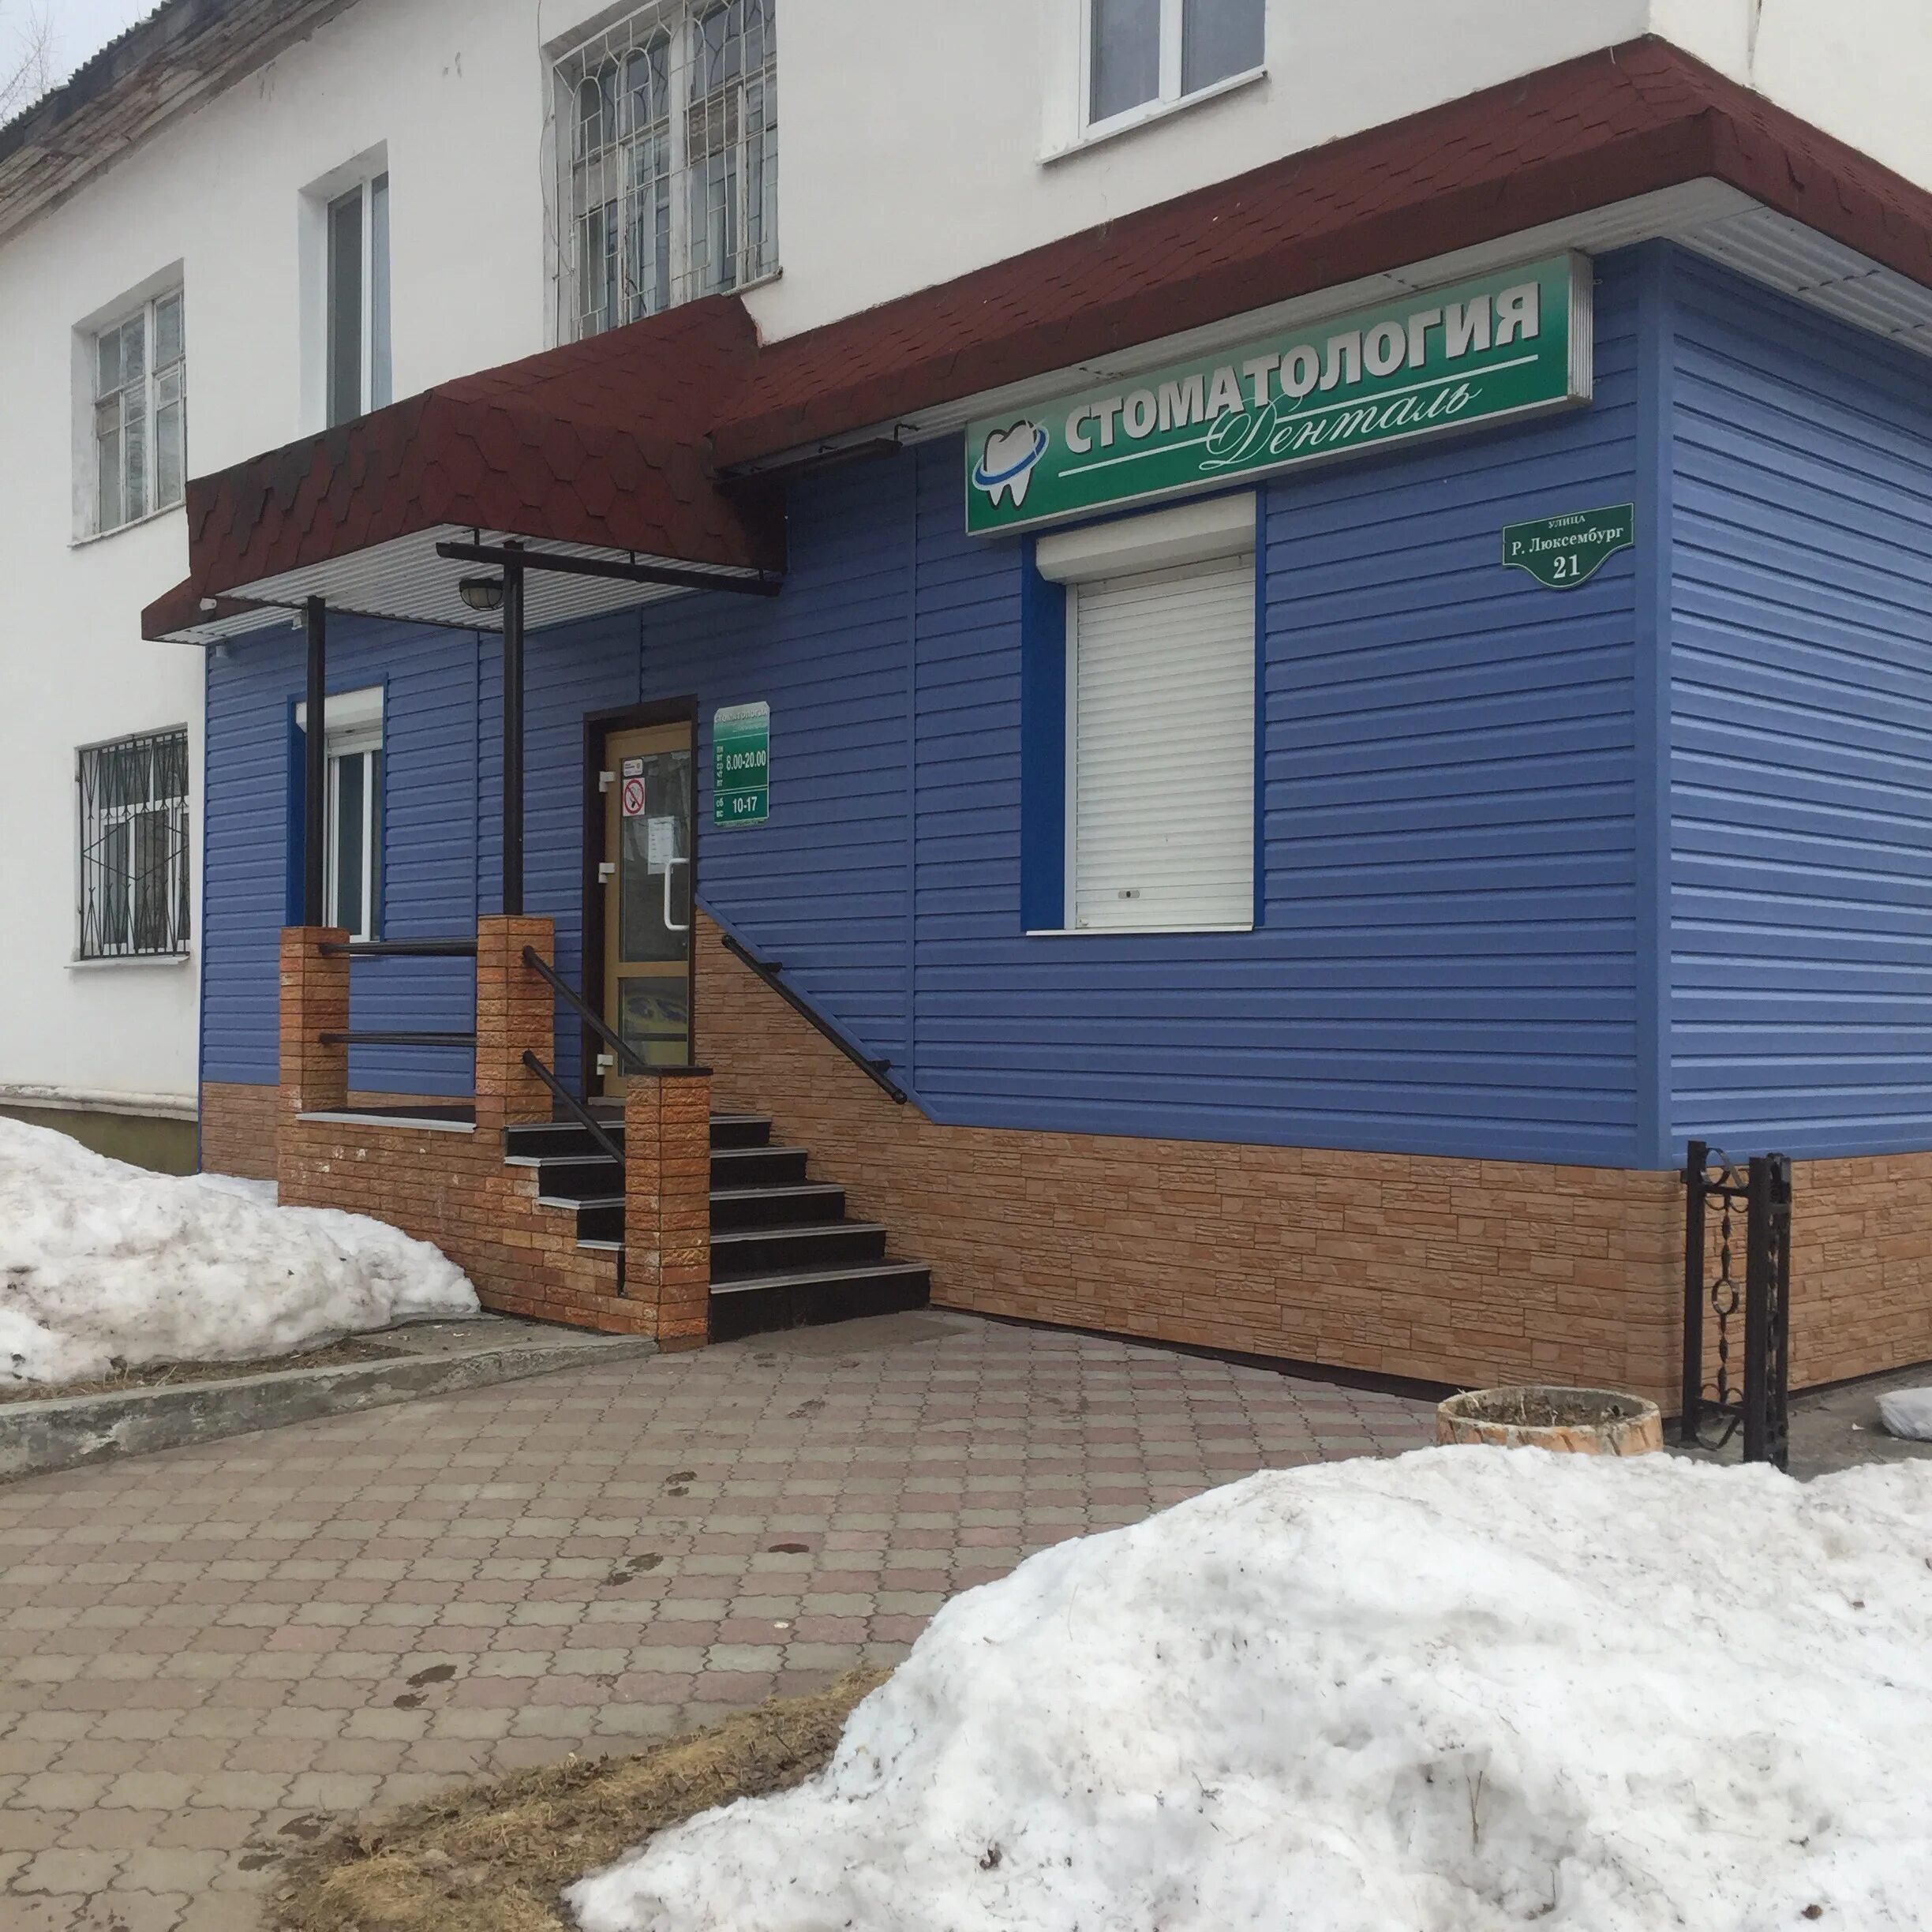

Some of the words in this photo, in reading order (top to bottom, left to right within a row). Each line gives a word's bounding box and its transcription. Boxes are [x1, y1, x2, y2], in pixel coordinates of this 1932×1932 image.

[1065, 281, 1541, 454] СТОМАТОЛОГИЯ
[1199, 382, 1483, 471] Денталь
[1548, 515, 1586, 529] УЛИЦА
[1511, 541, 1525, 556] Р.
[1529, 526, 1624, 552] Люксембург
[1552, 554, 1581, 579] 21
[726, 750, 766, 770] 8.00-20.00
[732, 796, 758, 814] 10-17
